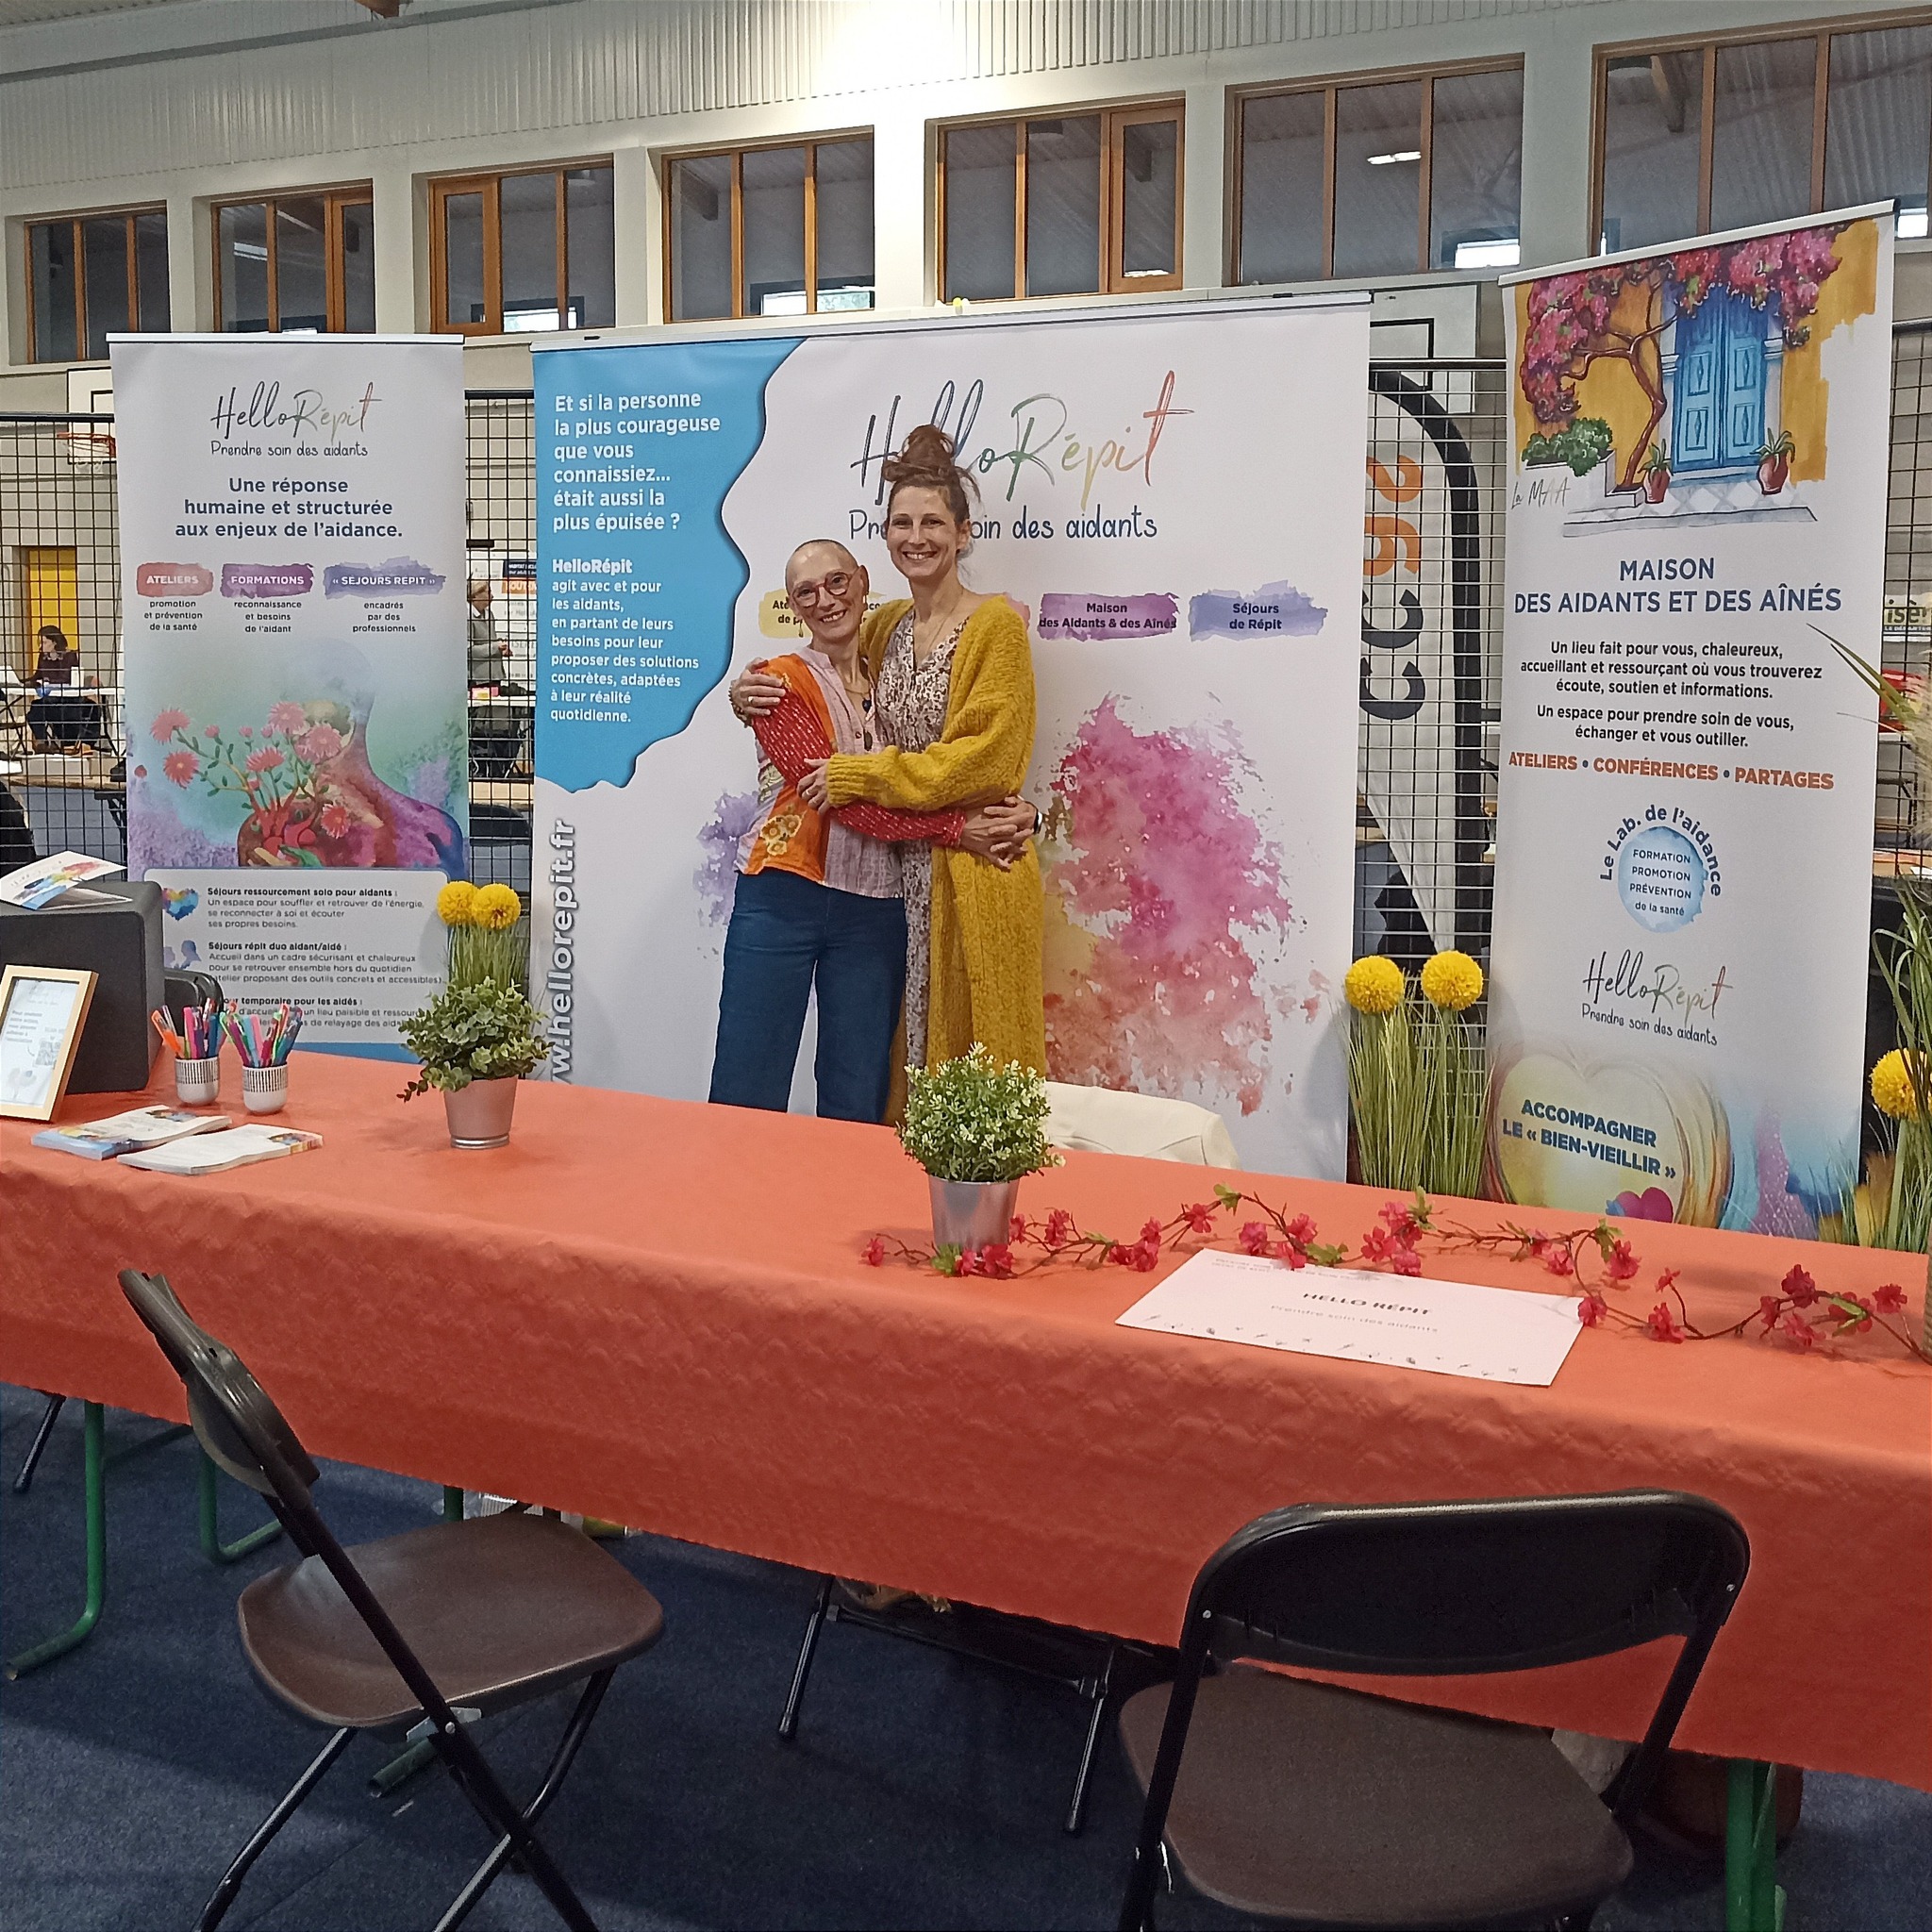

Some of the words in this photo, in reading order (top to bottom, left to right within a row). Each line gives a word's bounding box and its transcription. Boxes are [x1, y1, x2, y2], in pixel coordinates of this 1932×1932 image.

[209, 380, 383, 441] HelloRépit
[556, 395, 574, 412] Et
[579, 394, 592, 411] si
[599, 393, 612, 410] la
[619, 393, 701, 413] personne
[556, 419, 569, 436] la
[575, 418, 611, 439] plus
[617, 418, 720, 436] courageuse
[211, 441, 262, 456] Prendre
[267, 441, 291, 457] soin
[296, 441, 319, 456] des
[324, 441, 368, 457] aidants
[555, 446, 587, 462] que
[593, 445, 633, 458] vous
[229, 477, 265, 492] Une
[273, 477, 348, 495] réponse
[185, 499, 265, 514] humaine
[272, 501, 291, 514] et
[297, 499, 392, 514] structurée
[554, 490, 594, 507] était
[600, 489, 643, 506] aussi
[650, 489, 664, 506] la
[554, 513, 590, 533] plus
[595, 512, 664, 533] épuisée
[671, 513, 680, 529] ?
[1012, 505, 1054, 539] des
[1066, 504, 1158, 539] aidants
[175, 525, 208, 536] aux
[215, 522, 277, 540] enjeux
[284, 522, 308, 537] de
[314, 522, 402, 537] l'aidance.
[553, 558, 632, 575] HelloRépit
[1620, 558, 1714, 581] MAISON
[146, 575, 199, 585] ATELIERS
[231, 575, 305, 585] FORMATIONS
[552, 579, 576, 593] agit
[580, 582, 610, 591] avec
[614, 580, 627, 591] et
[631, 582, 661, 594] pour
[553, 597, 569, 609] les
[573, 597, 624, 612] aidants,
[1515, 593, 1551, 613] DES
[1557, 591, 1660, 613] AIDANTS
[1669, 591, 1697, 612] ET
[1706, 590, 1751, 612] DES
[1759, 582, 1841, 611] AÎNÉS
[155, 611, 203, 620] prévention
[1086, 603, 1127, 613] Maison
[1232, 603, 1279, 616] Séjours
[353, 625, 416, 633] professionnels
[552, 619, 566, 627] en
[571, 617, 618, 630] partant
[622, 617, 639, 629] de
[642, 617, 674, 630] leurs
[1039, 617, 1059, 628] des
[1061, 618, 1106, 628] Aidants
[1108, 618, 1117, 628] &
[1119, 618, 1141, 628] des
[1143, 617, 1176, 629] Aînés
[1229, 619, 1245, 629] de
[1248, 619, 1282, 632] Répit
[552, 634, 600, 647] besoins
[604, 638, 635, 650] pour
[639, 636, 663, 648] leur
[1551, 641, 1567, 654] Un
[1572, 641, 1595, 654] lieu
[1600, 641, 1623, 655] fait
[1626, 644, 1658, 657] pour
[1662, 645, 1697, 658] vous,
[1702, 641, 1783, 659] chaleureux,
[552, 656, 609, 667] proposer
[613, 654, 636, 667] des
[640, 655, 699, 669] solutions
[1521, 659, 1587, 673] accueillant
[1591, 661, 1605, 674] et
[1608, 662, 1688, 677] ressourçant
[1691, 661, 1708, 675] où
[1714, 665, 1745, 676] vous
[1750, 664, 1823, 678] trouverez
[551, 672, 617, 687] concrètes,
[621, 673, 680, 688] adaptées
[1557, 678, 1604, 694] écoute,
[1608, 680, 1658, 694] soutien
[1663, 682, 1677, 695] et
[1681, 681, 1773, 698] informations.
[551, 689, 558, 701] à
[561, 690, 586, 702] leur
[590, 691, 631, 704] réalité
[551, 708, 631, 722] quotidienne.
[1538, 705, 1553, 717] Un
[1557, 708, 1603, 721] espace
[1607, 710, 1640, 723] pour
[1643, 709, 1697, 724] prendre
[1701, 711, 1729, 725] soin
[1734, 712, 1752, 726] de
[1757, 717, 1793, 731] vous,
[1575, 724, 1638, 742] échanger
[1642, 729, 1656, 741] et
[1660, 732, 1691, 743] vous
[1695, 732, 1748, 747] outiller.
[1508, 751, 1577, 770] ATELIERS
[1593, 757, 1718, 781] CONFÉRENCES
[1735, 767, 1834, 790] PARTAGES
[1600, 855, 1614, 881] Le
[1607, 817, 1641, 851] Lab.
[1644, 804, 1667, 821] de
[1672, 807, 1722, 897] l'aidance
[1633, 849, 1690, 863] FORMATION
[1632, 866, 1690, 881] PROMOTION
[1629, 883, 1691, 899] PRÉVENTION
[1635, 901, 1646, 910] de
[1649, 903, 1657, 912] la
[1660, 906, 1685, 916] santé
[1582, 948, 1734, 1025] HelloRépit
[1629, 1017, 1650, 1031] soin
[1676, 1025, 1718, 1046] aidants
[1521, 1099, 1657, 1153] ACCOMPAGNER
[1502, 1118, 1523, 1139] LE
[1541, 1127, 1661, 1175] BIEN-VIEILLIR
